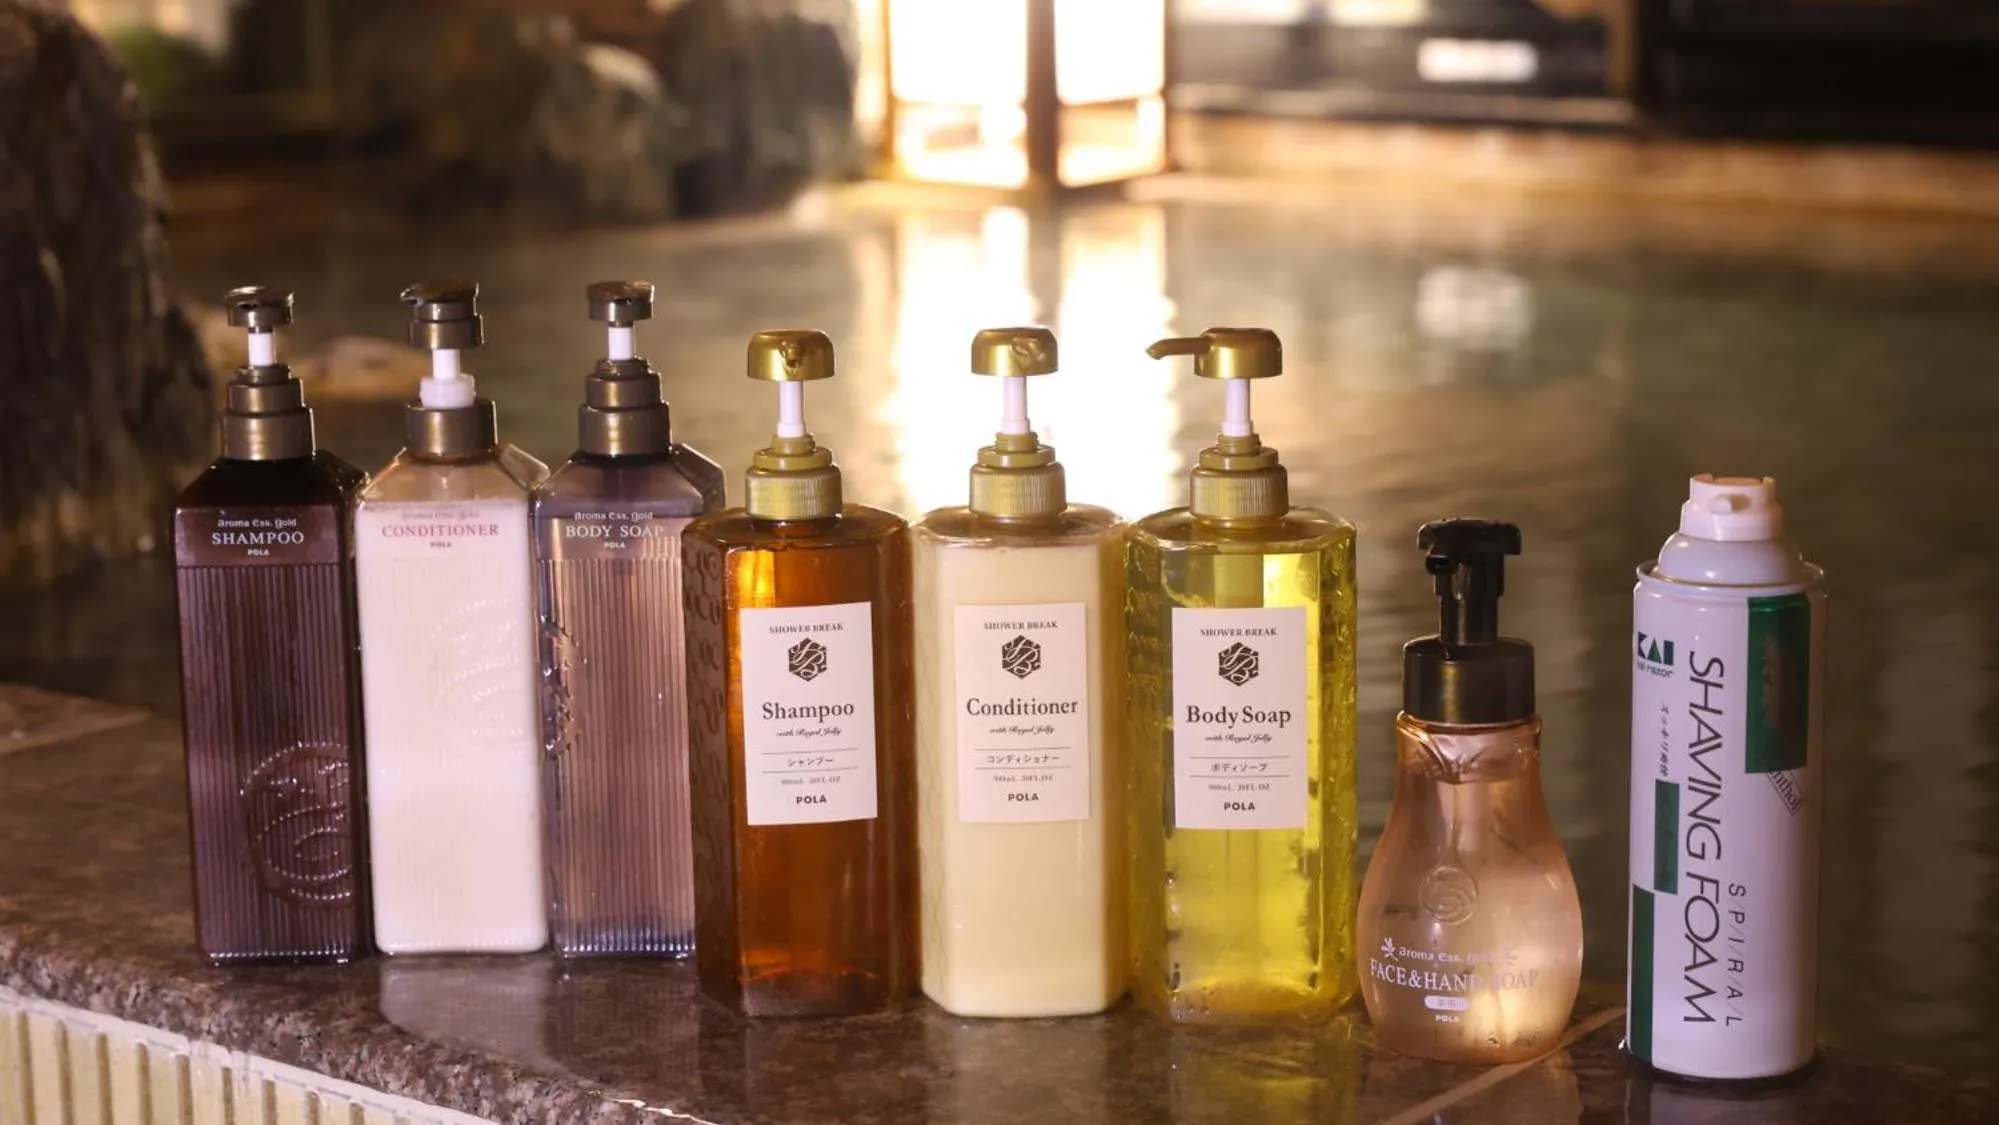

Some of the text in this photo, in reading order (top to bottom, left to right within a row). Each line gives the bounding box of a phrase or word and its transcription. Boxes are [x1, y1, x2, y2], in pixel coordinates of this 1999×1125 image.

[381, 523, 499, 538] CONDITIONER
[565, 524, 664, 538] BODY SOAP
[211, 530, 305, 546] SHAMPOO
[604, 541, 626, 549] POLA
[247, 548, 270, 556] POLA
[769, 622, 844, 634] SHOWER BREAK
[983, 620, 1059, 631] SHOWER BREAK
[1200, 627, 1278, 638] SHOWER BREAK
[1637, 630, 1674, 667] KAI
[762, 701, 855, 723] Shampoo
[966, 697, 1078, 717] Conditioner
[1185, 705, 1291, 729] Body Soap
[788, 756, 835, 767] シャンプー
[986, 753, 1061, 764] コンディショナー
[1210, 761, 1270, 773] ボディソープ
[796, 794, 827, 805] POLA
[1007, 792, 1039, 802] POLA
[1223, 802, 1256, 812] POLA
[1683, 650, 1724, 1023] SHAVING FOAM
[1435, 1013, 1460, 1023] POLA
